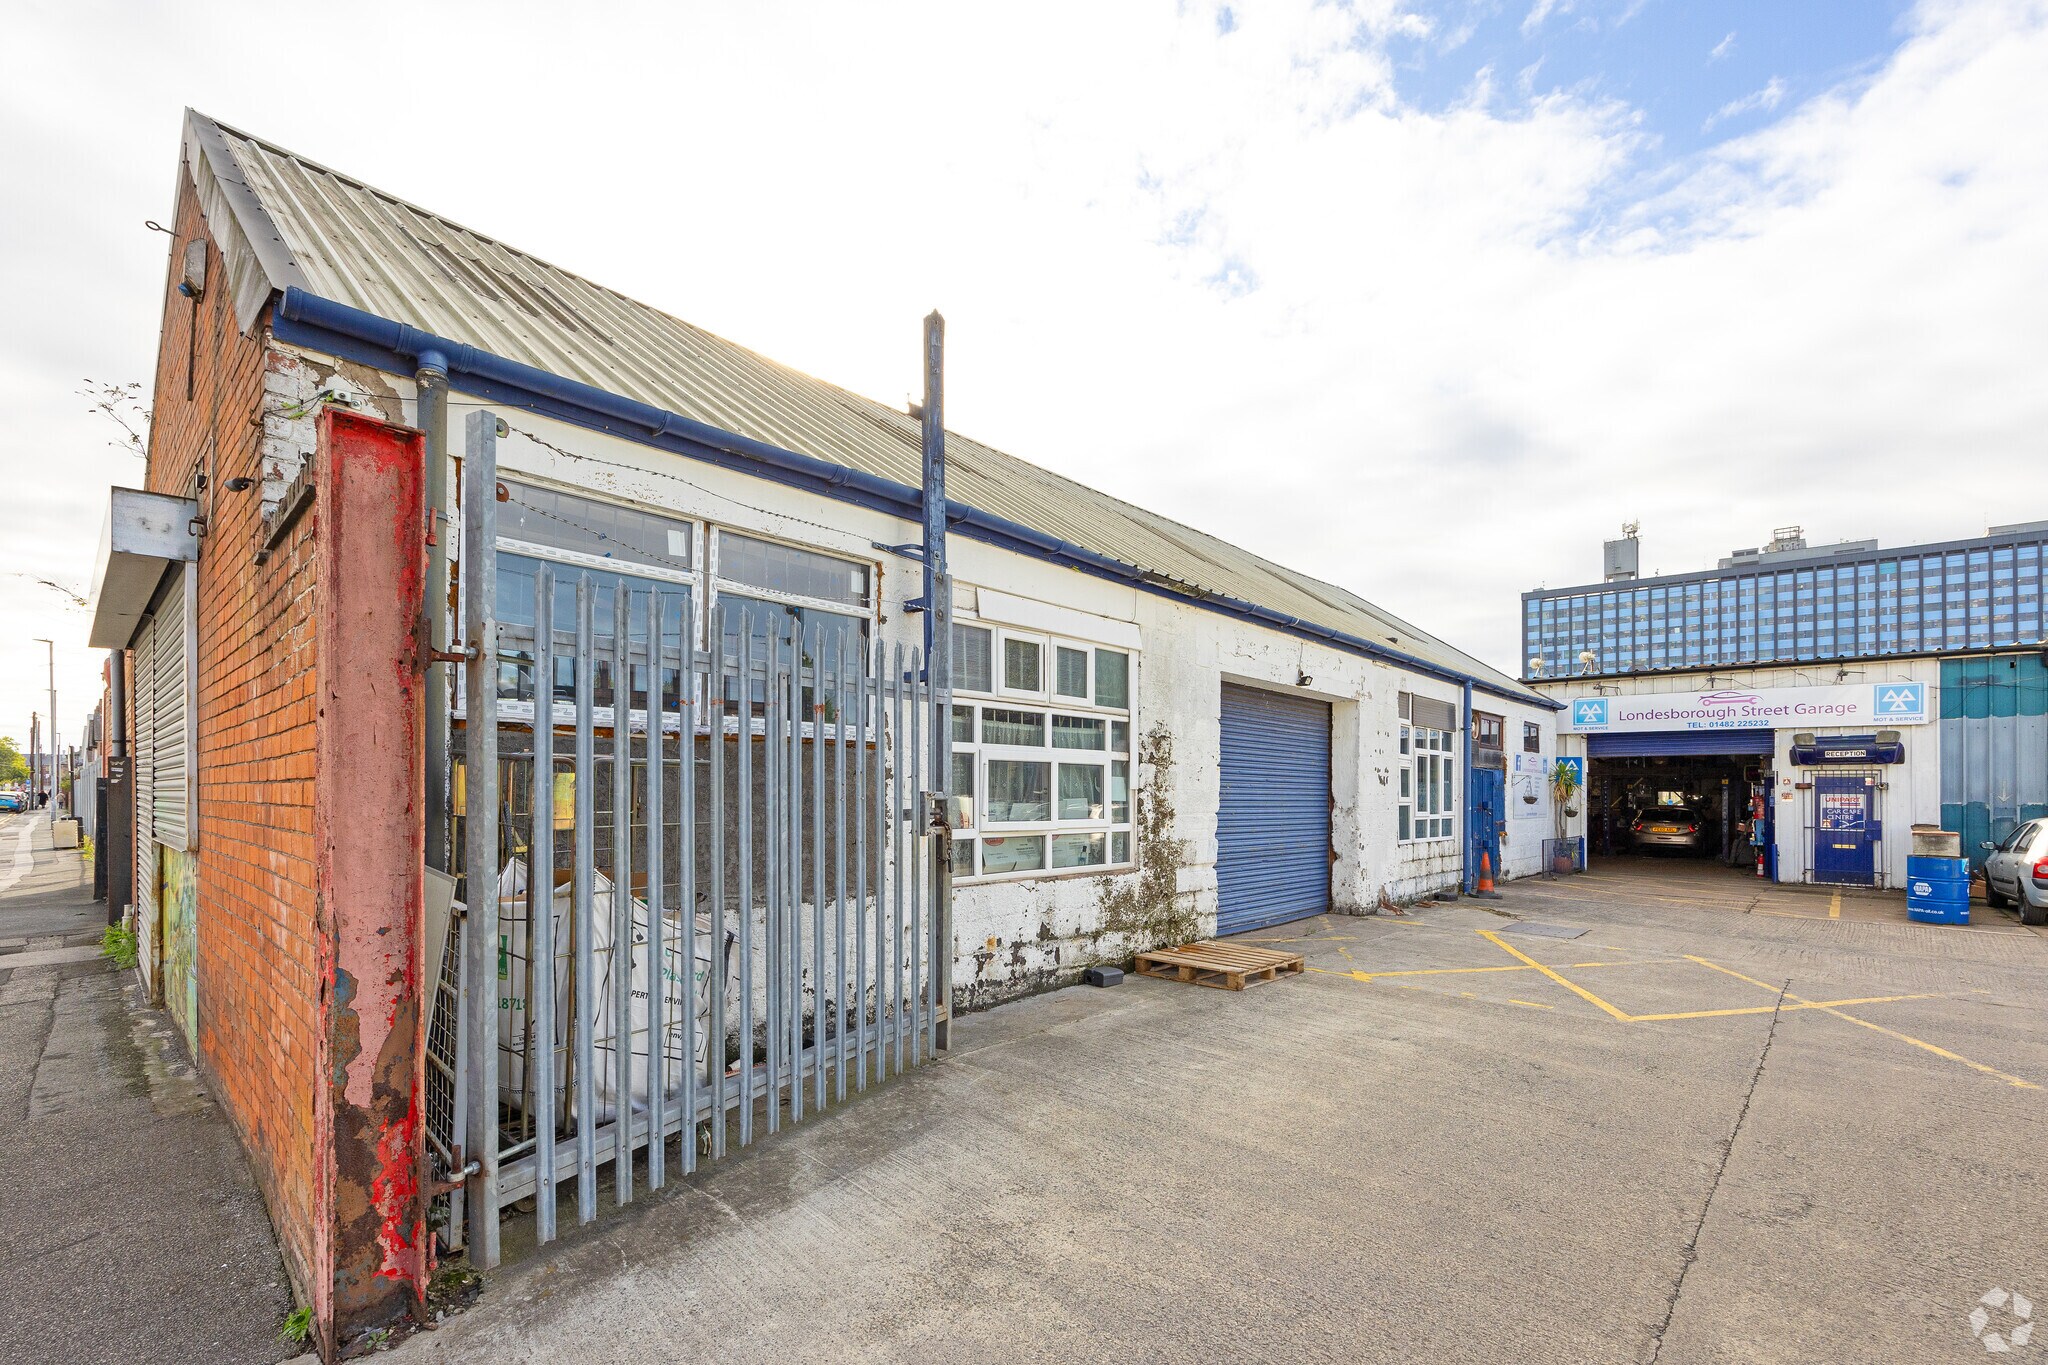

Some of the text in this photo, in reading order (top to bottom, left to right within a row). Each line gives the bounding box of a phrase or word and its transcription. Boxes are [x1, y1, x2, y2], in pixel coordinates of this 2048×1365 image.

[1618, 703, 1857, 721] Londesborough Street Garage
